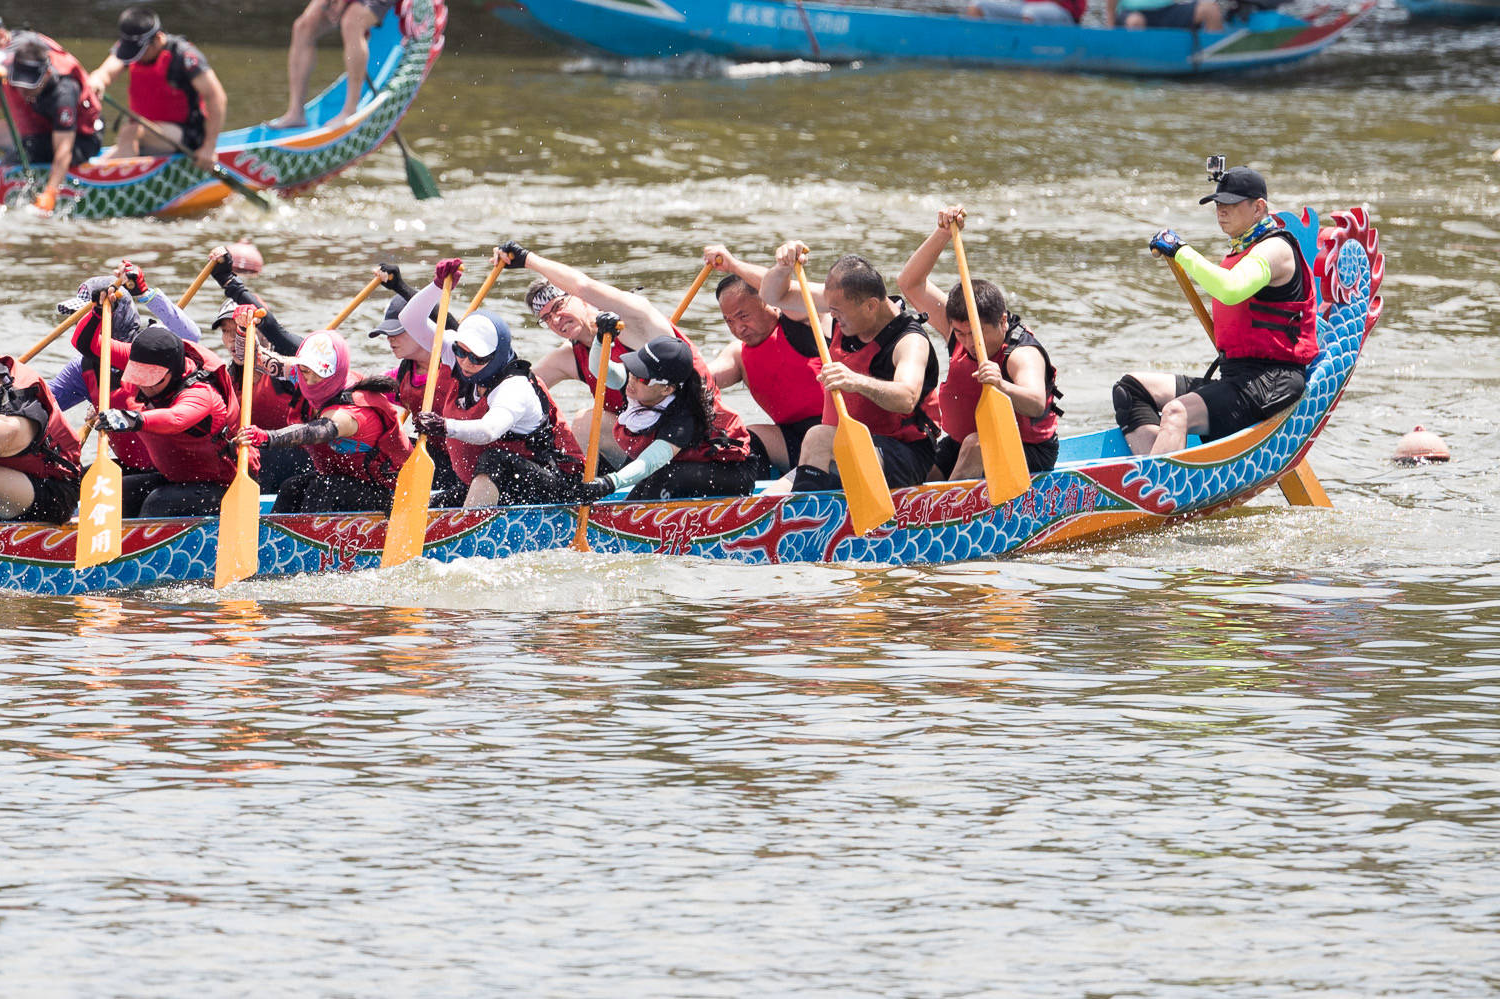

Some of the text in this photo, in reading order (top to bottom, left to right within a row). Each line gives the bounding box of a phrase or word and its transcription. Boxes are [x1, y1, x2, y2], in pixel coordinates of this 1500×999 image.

[87, 474, 116, 554] 大會用
[894, 483, 1100, 530] 台北市台省城隍廟贈
